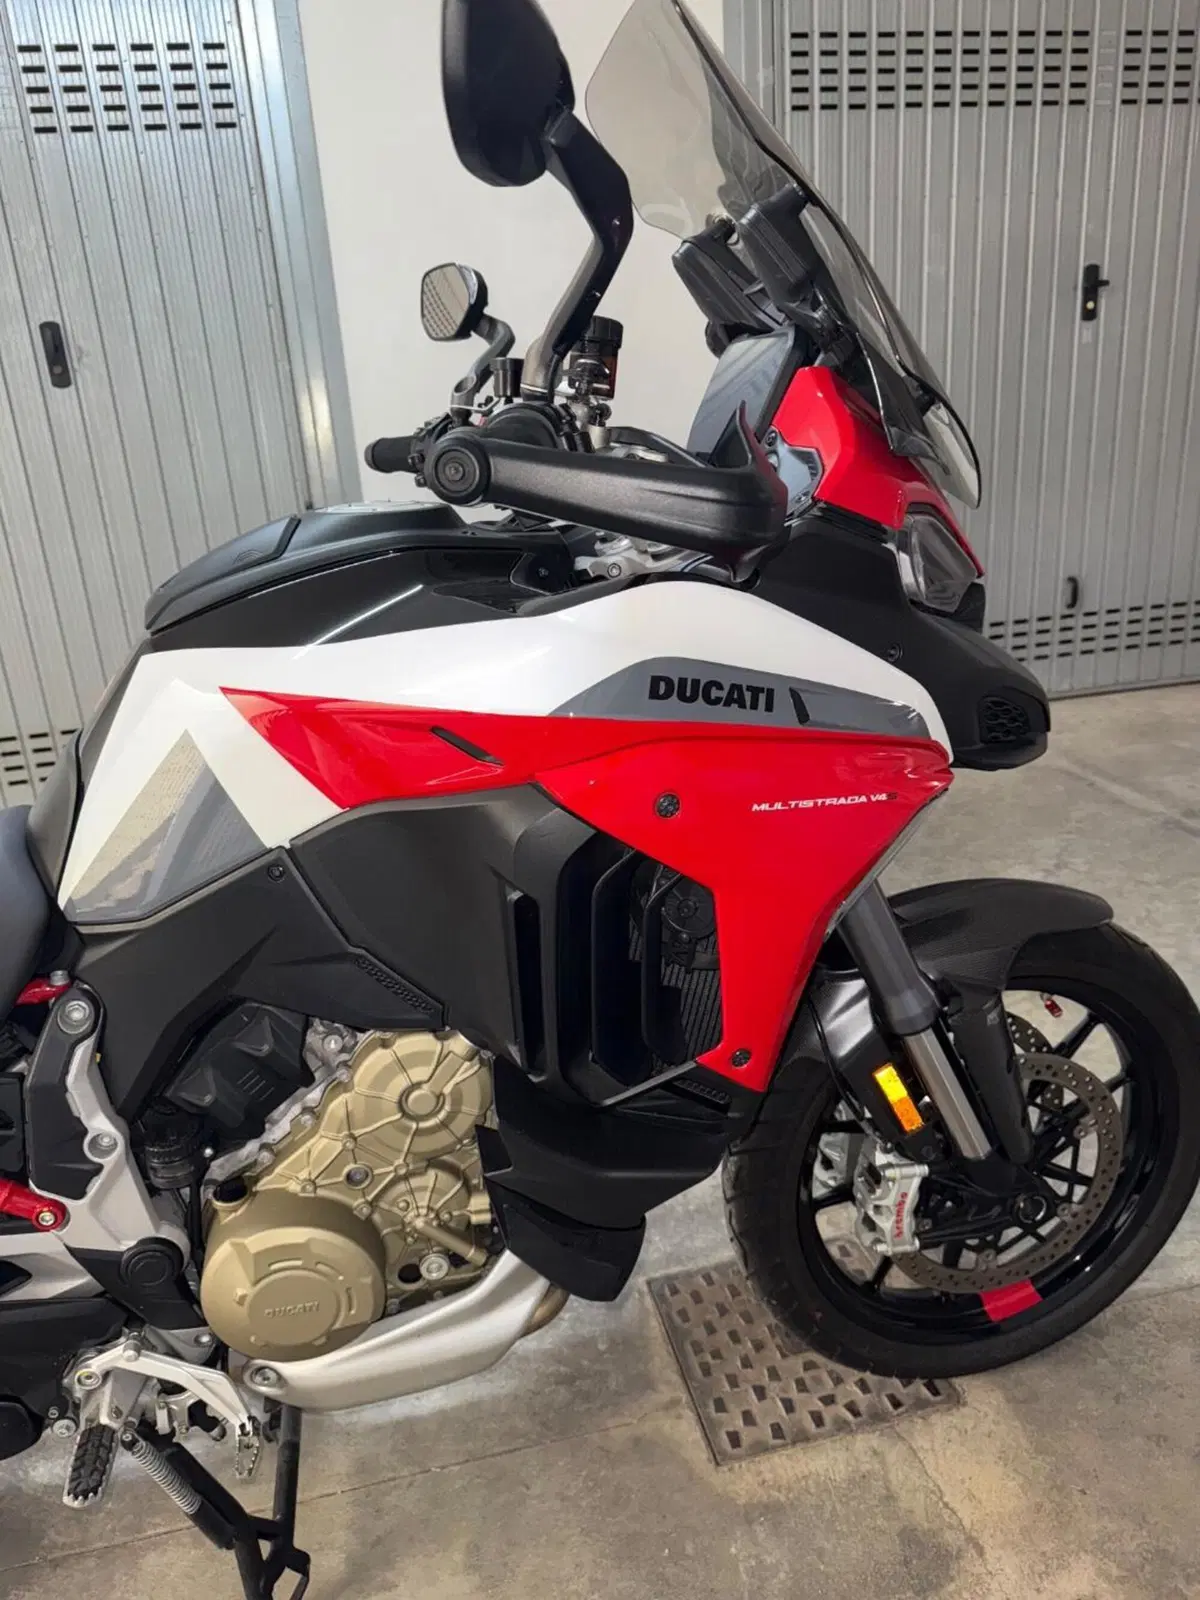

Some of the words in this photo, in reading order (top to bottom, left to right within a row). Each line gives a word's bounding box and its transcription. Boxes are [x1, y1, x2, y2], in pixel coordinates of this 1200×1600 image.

[648, 675, 775, 713] DUCATI
[752, 794, 867, 812] MULTISTRADA
[264, 1300, 320, 1318] DUCATI
